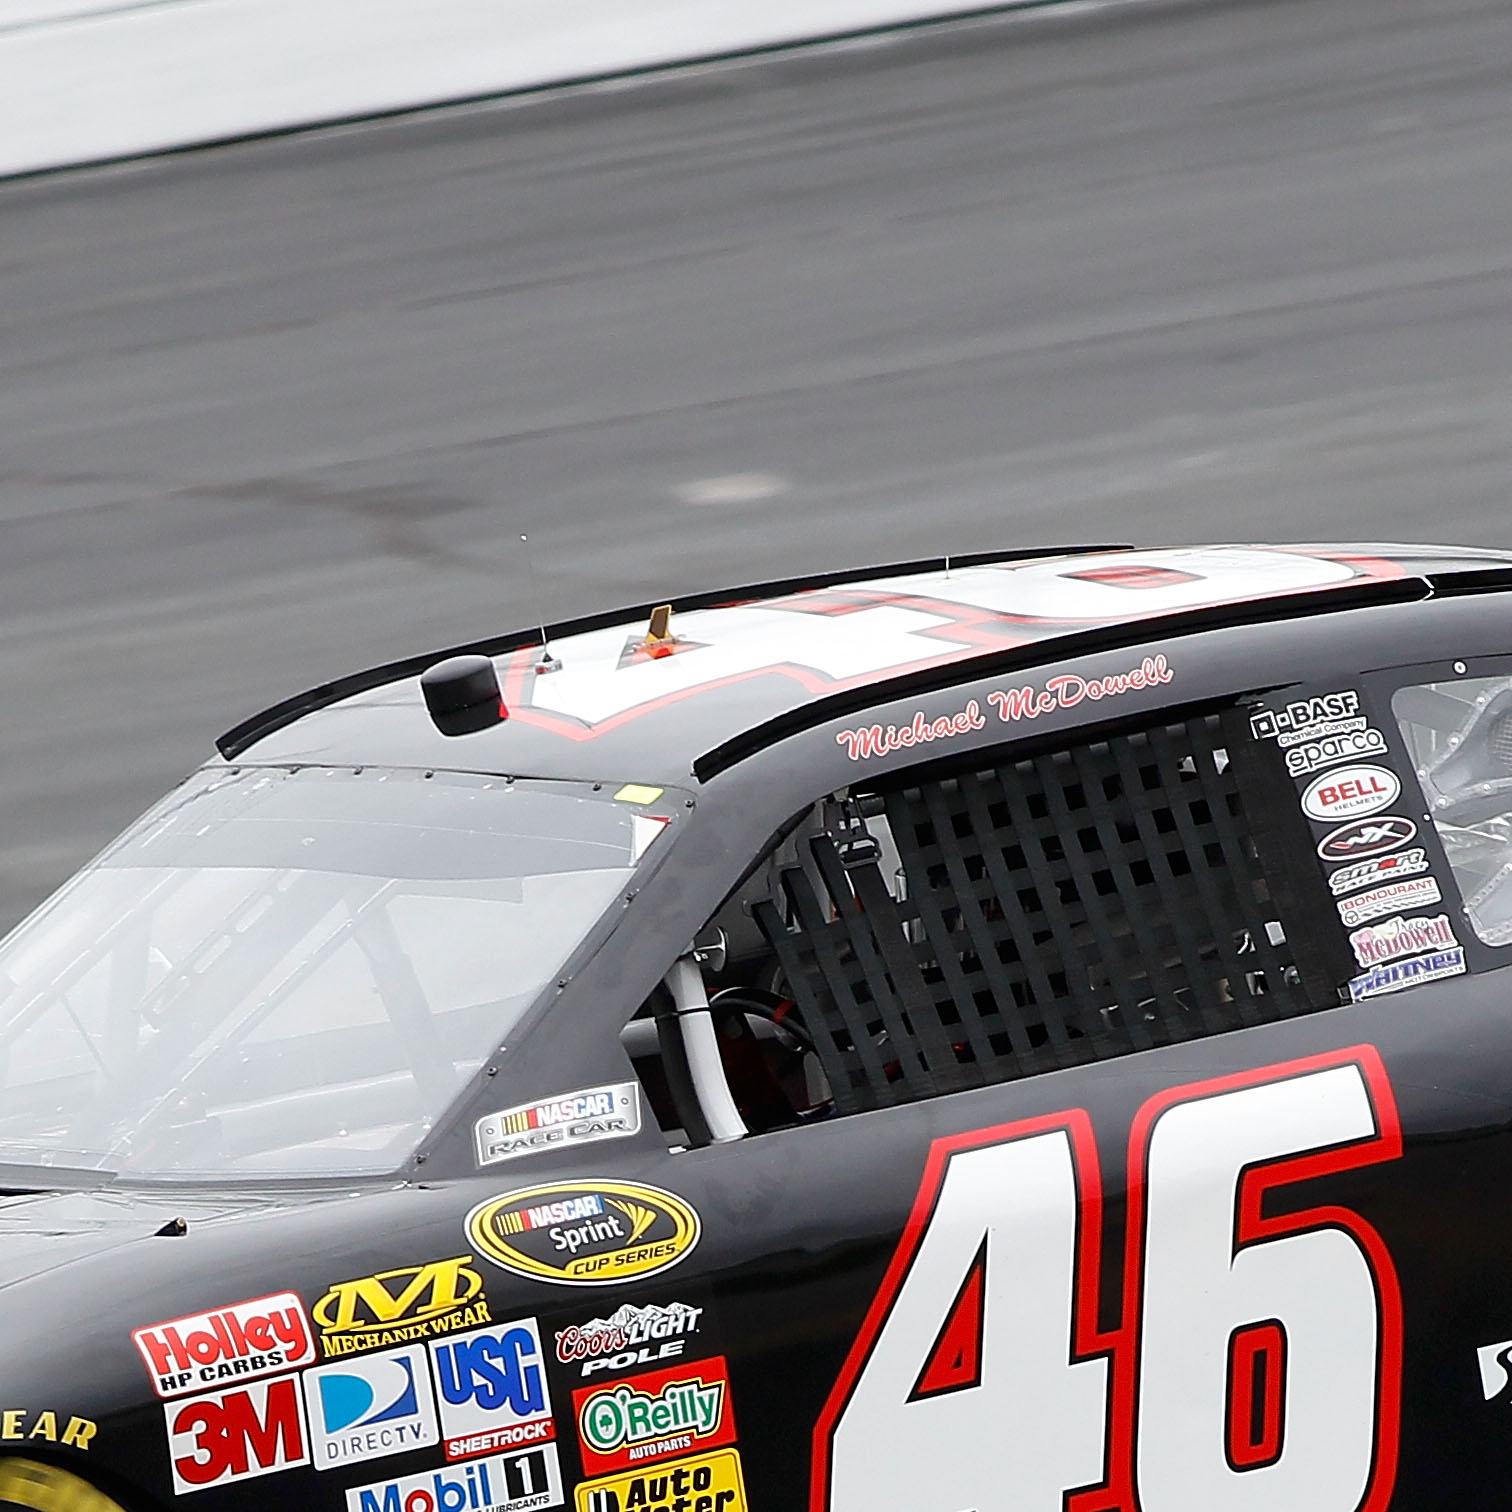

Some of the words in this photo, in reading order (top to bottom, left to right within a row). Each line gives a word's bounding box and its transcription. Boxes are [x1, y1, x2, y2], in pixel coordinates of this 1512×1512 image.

[836, 700, 986, 760] Michael
[988, 654, 1175, 723] McDowell
[1289, 693, 1359, 727] BASF
[1279, 726, 1323, 745] Chemical
[1324, 718, 1365, 736] Company
[1288, 731, 1382, 769] sparco
[1317, 776, 1388, 807] BELL
[1334, 795, 1384, 812] HELMETS
[1332, 852, 1422, 886] smart
[1343, 879, 1433, 912] BONDURANT
[1356, 920, 1453, 965] McDowell
[536, 1092, 613, 1127] NASCAR
[490, 1130, 565, 1156] RACE
[569, 1118, 626, 1138] CAR
[528, 1195, 604, 1229] NASCAR
[549, 1216, 625, 1254] Sprint
[573, 1259, 610, 1276] CUP
[615, 1242, 677, 1267] SERIES
[141, 1307, 306, 1374] Holley
[322, 1325, 431, 1358] MECHANIX
[434, 1301, 492, 1334] WEAR
[555, 1326, 628, 1363] Coors
[626, 1307, 703, 1345] LIGHT
[159, 1372, 192, 1392] HP
[199, 1351, 284, 1382] CARBS
[434, 1327, 546, 1417] USG
[581, 1340, 685, 1377] POLE
[172, 1380, 304, 1485] 3M
[587, 1389, 718, 1445] O'Reilly
[326, 1422, 424, 1460] DIRECTV
[448, 1423, 546, 1457] SHEETROCK
[628, 1445, 657, 1461] AUTO
[657, 1436, 692, 1454] PARTS
[515, 1456, 535, 1495] 1
[627, 1466, 712, 1508] Auto
